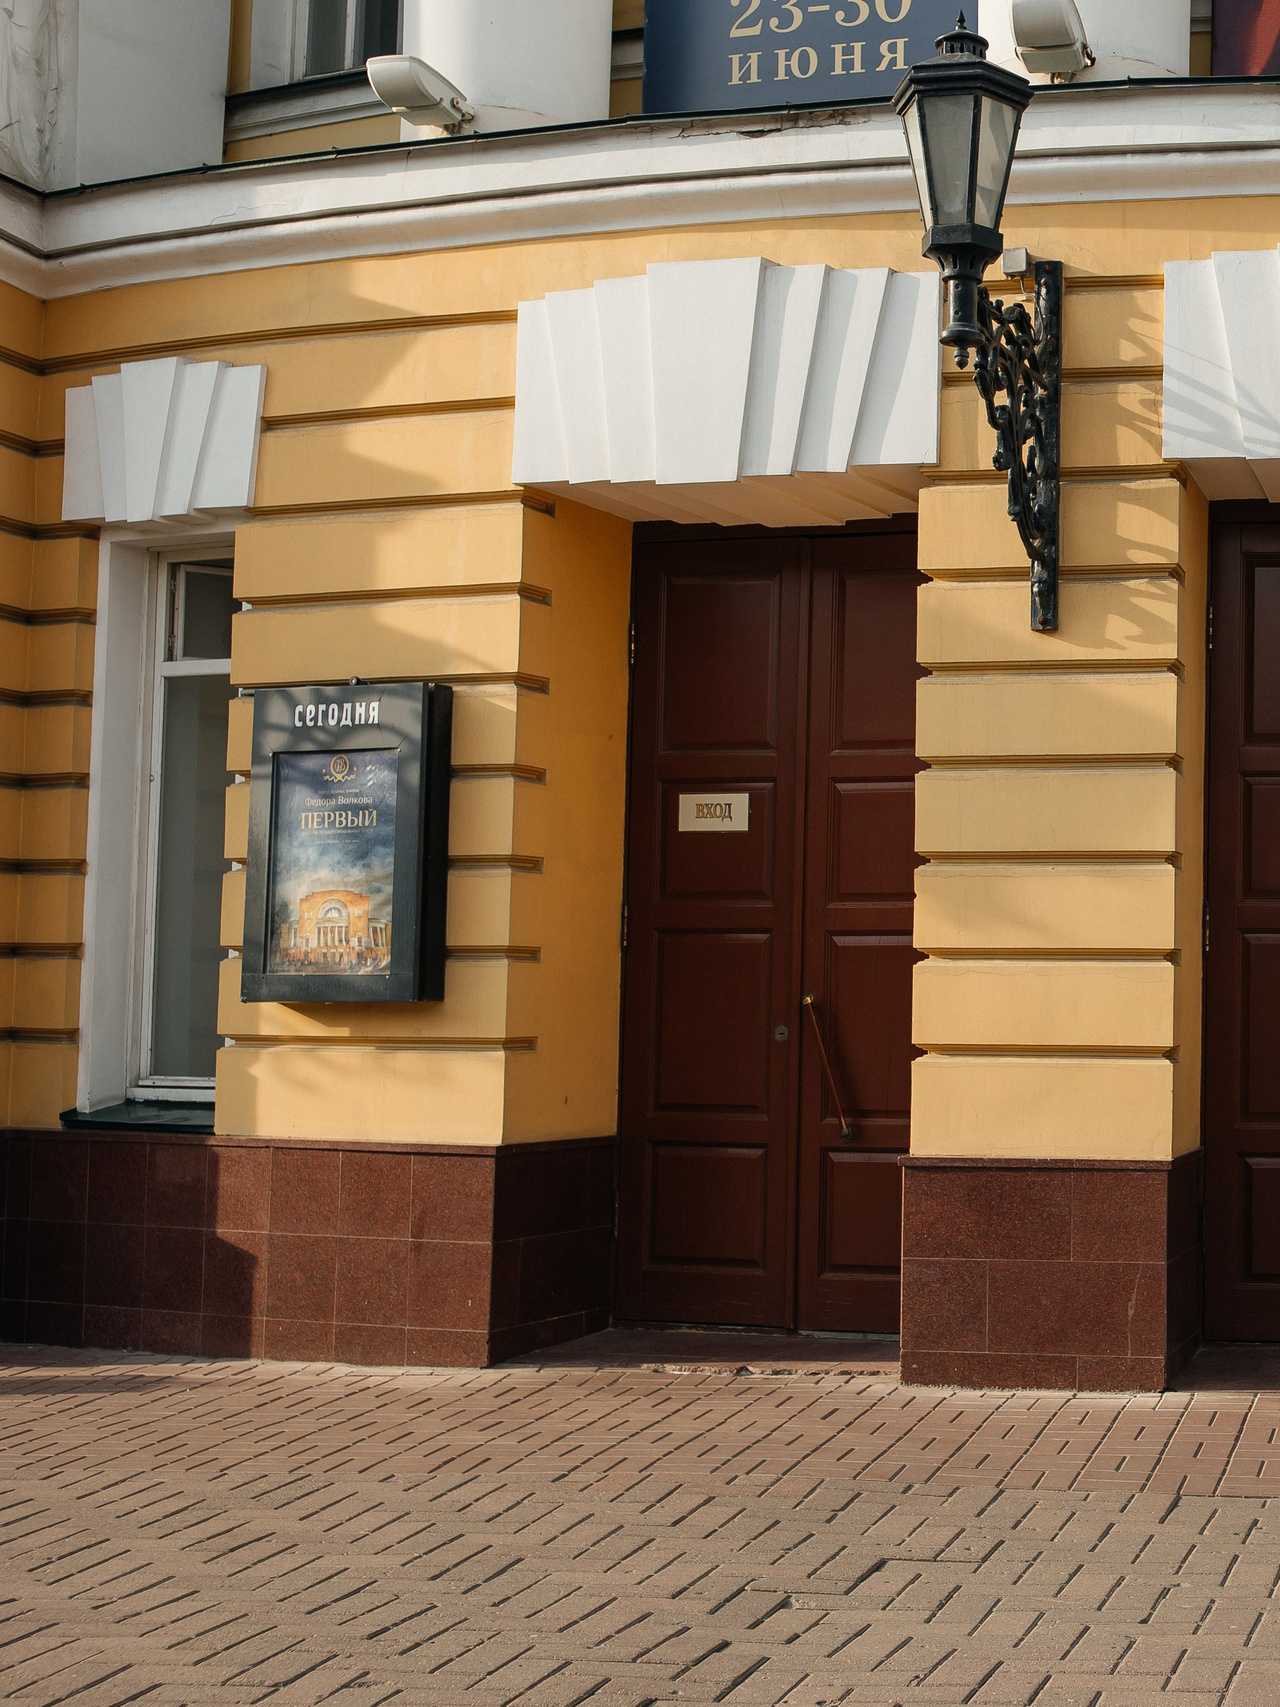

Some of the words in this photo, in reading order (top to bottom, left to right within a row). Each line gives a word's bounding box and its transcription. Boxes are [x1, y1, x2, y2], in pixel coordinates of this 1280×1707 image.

[727, 37, 909, 85] июня
[294, 701, 380, 727] сегодня
[304, 796, 336, 807] Федора
[338, 795, 373, 805] Волкова
[300, 808, 377, 829] ПЕРВЫЙ
[695, 803, 732, 822] ВХОД
